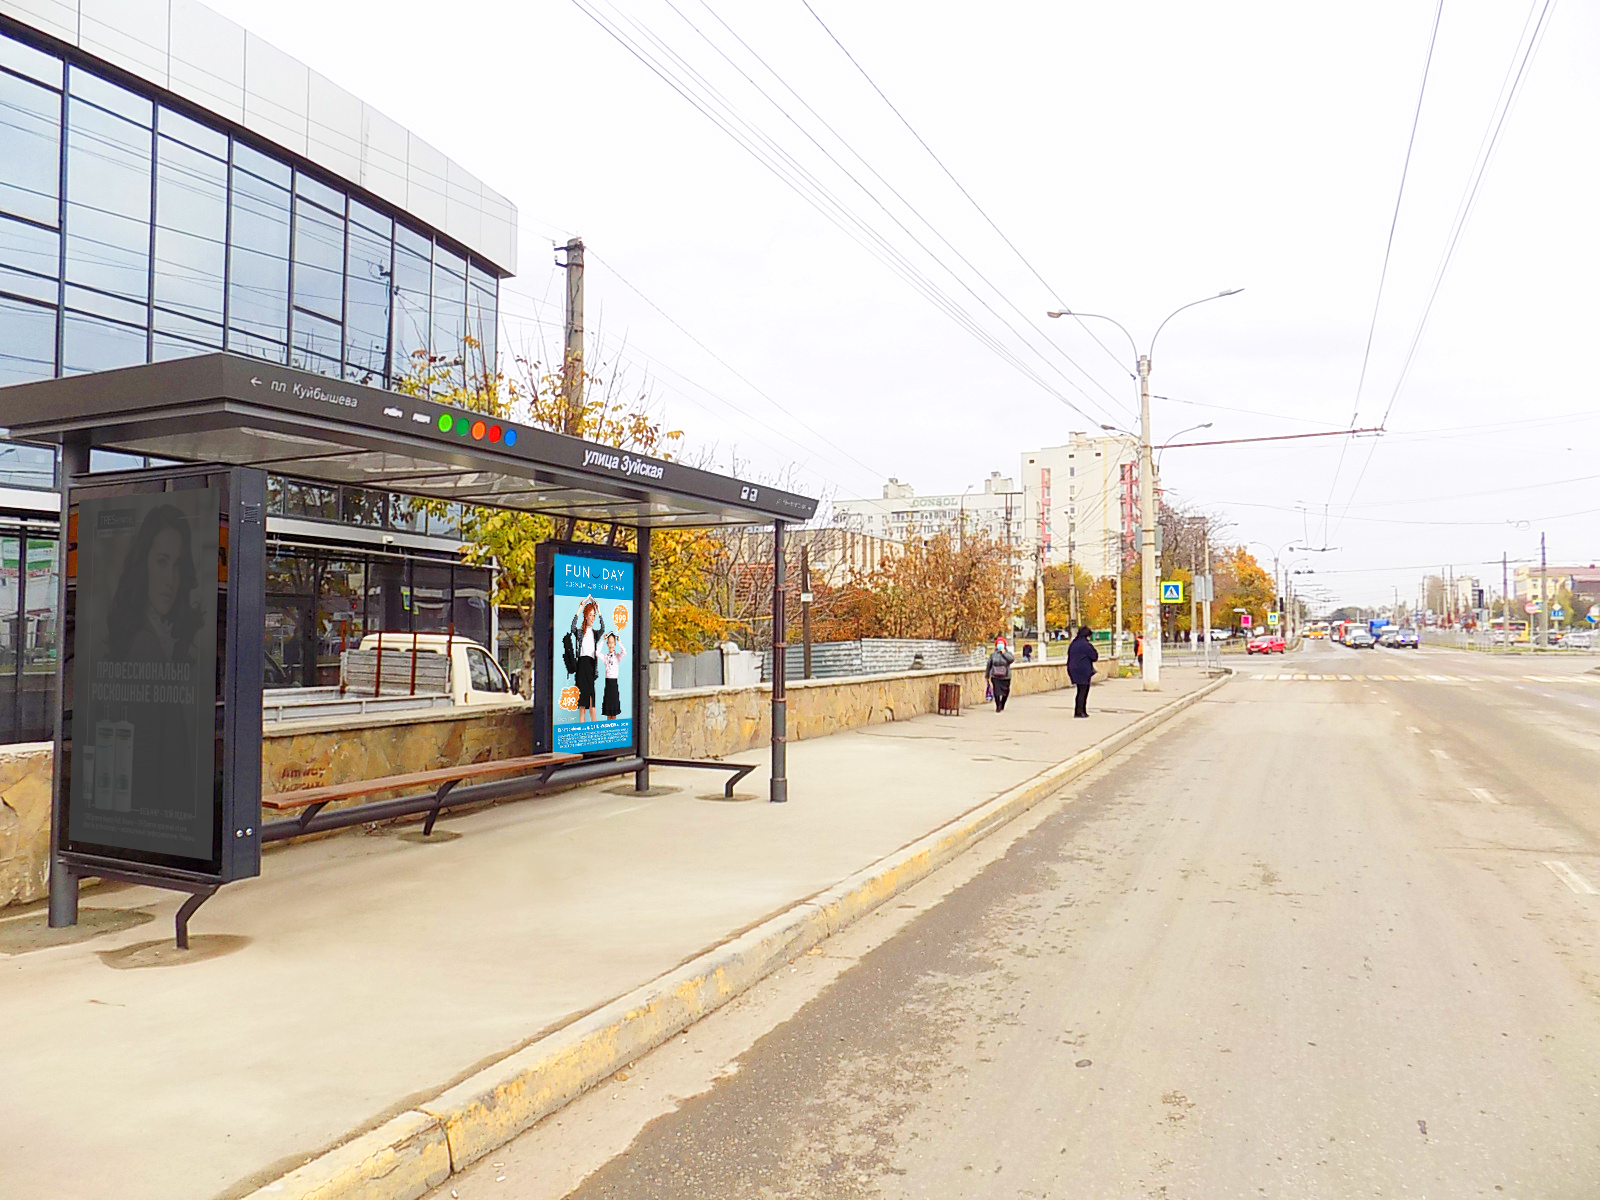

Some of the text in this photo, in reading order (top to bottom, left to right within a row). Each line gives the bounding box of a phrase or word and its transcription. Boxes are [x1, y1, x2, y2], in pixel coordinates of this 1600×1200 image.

[271, 380, 358, 408] пл Куйбышева
[582, 449, 664, 479] улица Зуйская
[912, 497, 958, 507] CONSOL
[565, 564, 625, 581] FUN DAY
[96, 661, 191, 681] ПРОФЕССИОНАЛЬНО
[92, 682, 195, 705] РОСКОШНЫЕ ВОЛОСЫ
